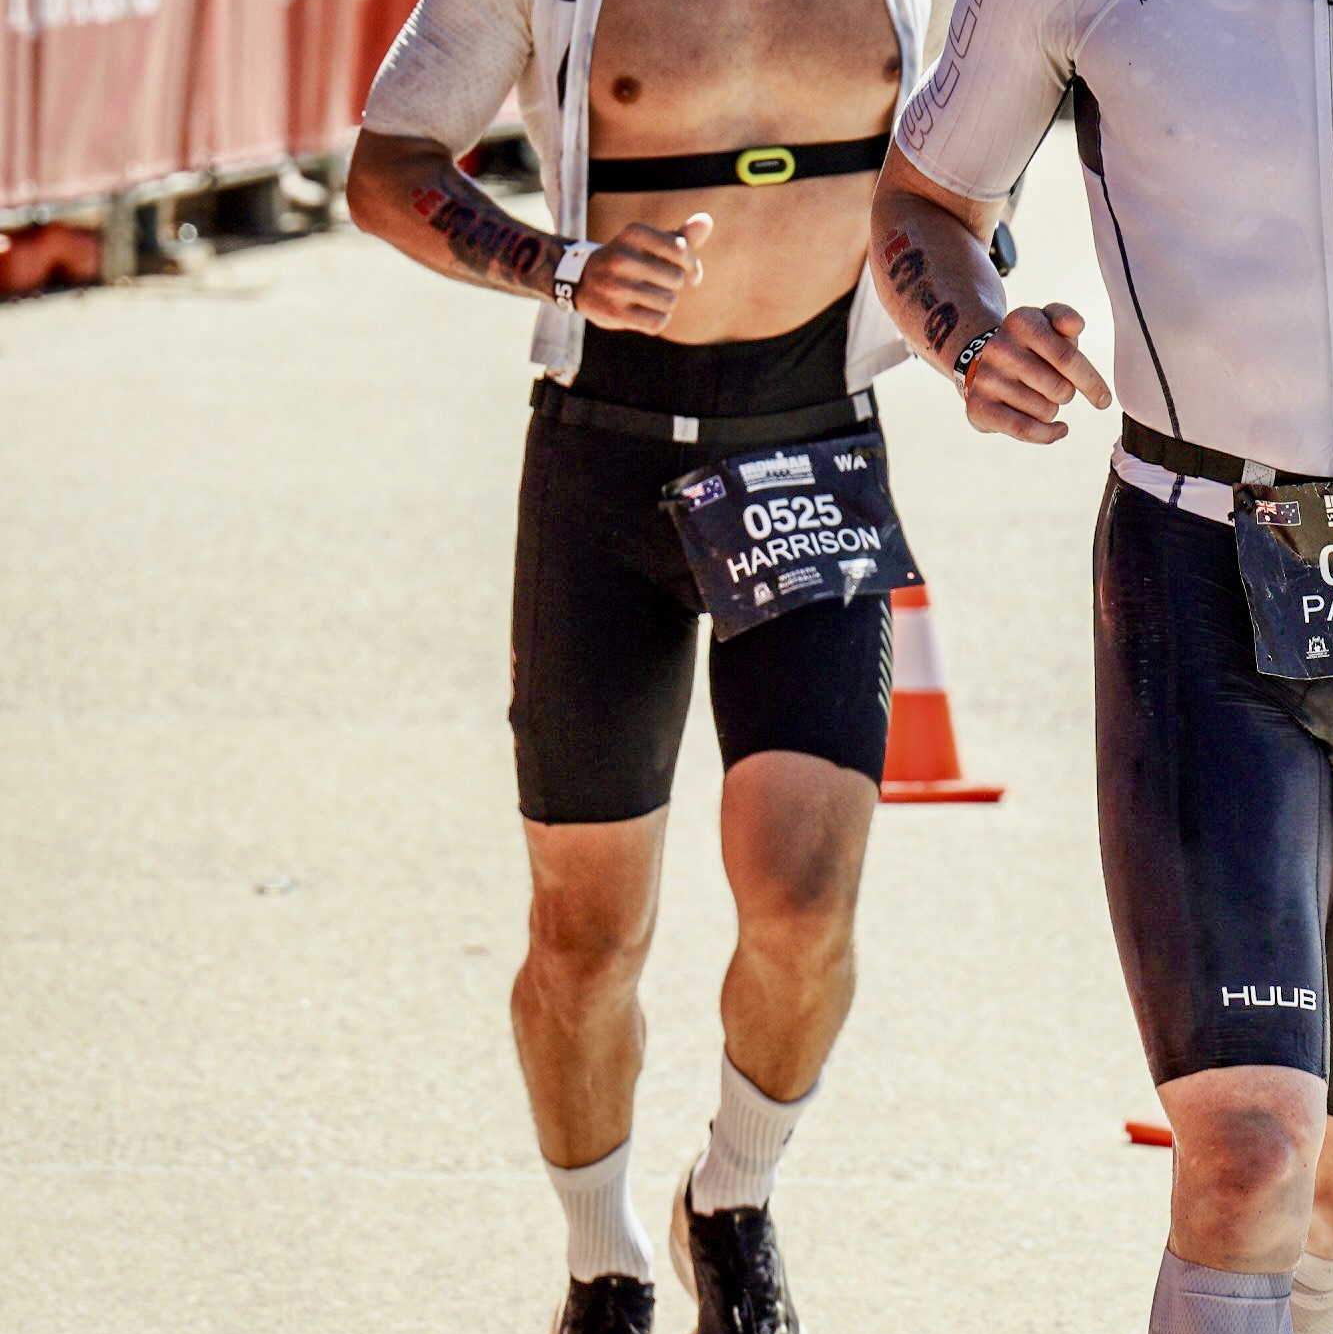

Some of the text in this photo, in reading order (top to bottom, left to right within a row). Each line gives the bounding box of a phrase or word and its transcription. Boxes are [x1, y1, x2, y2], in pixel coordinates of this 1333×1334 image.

[743, 493, 843, 541] 0525
[727, 525, 882, 584] HARRISON
[1221, 985, 1317, 1011] HUUB
